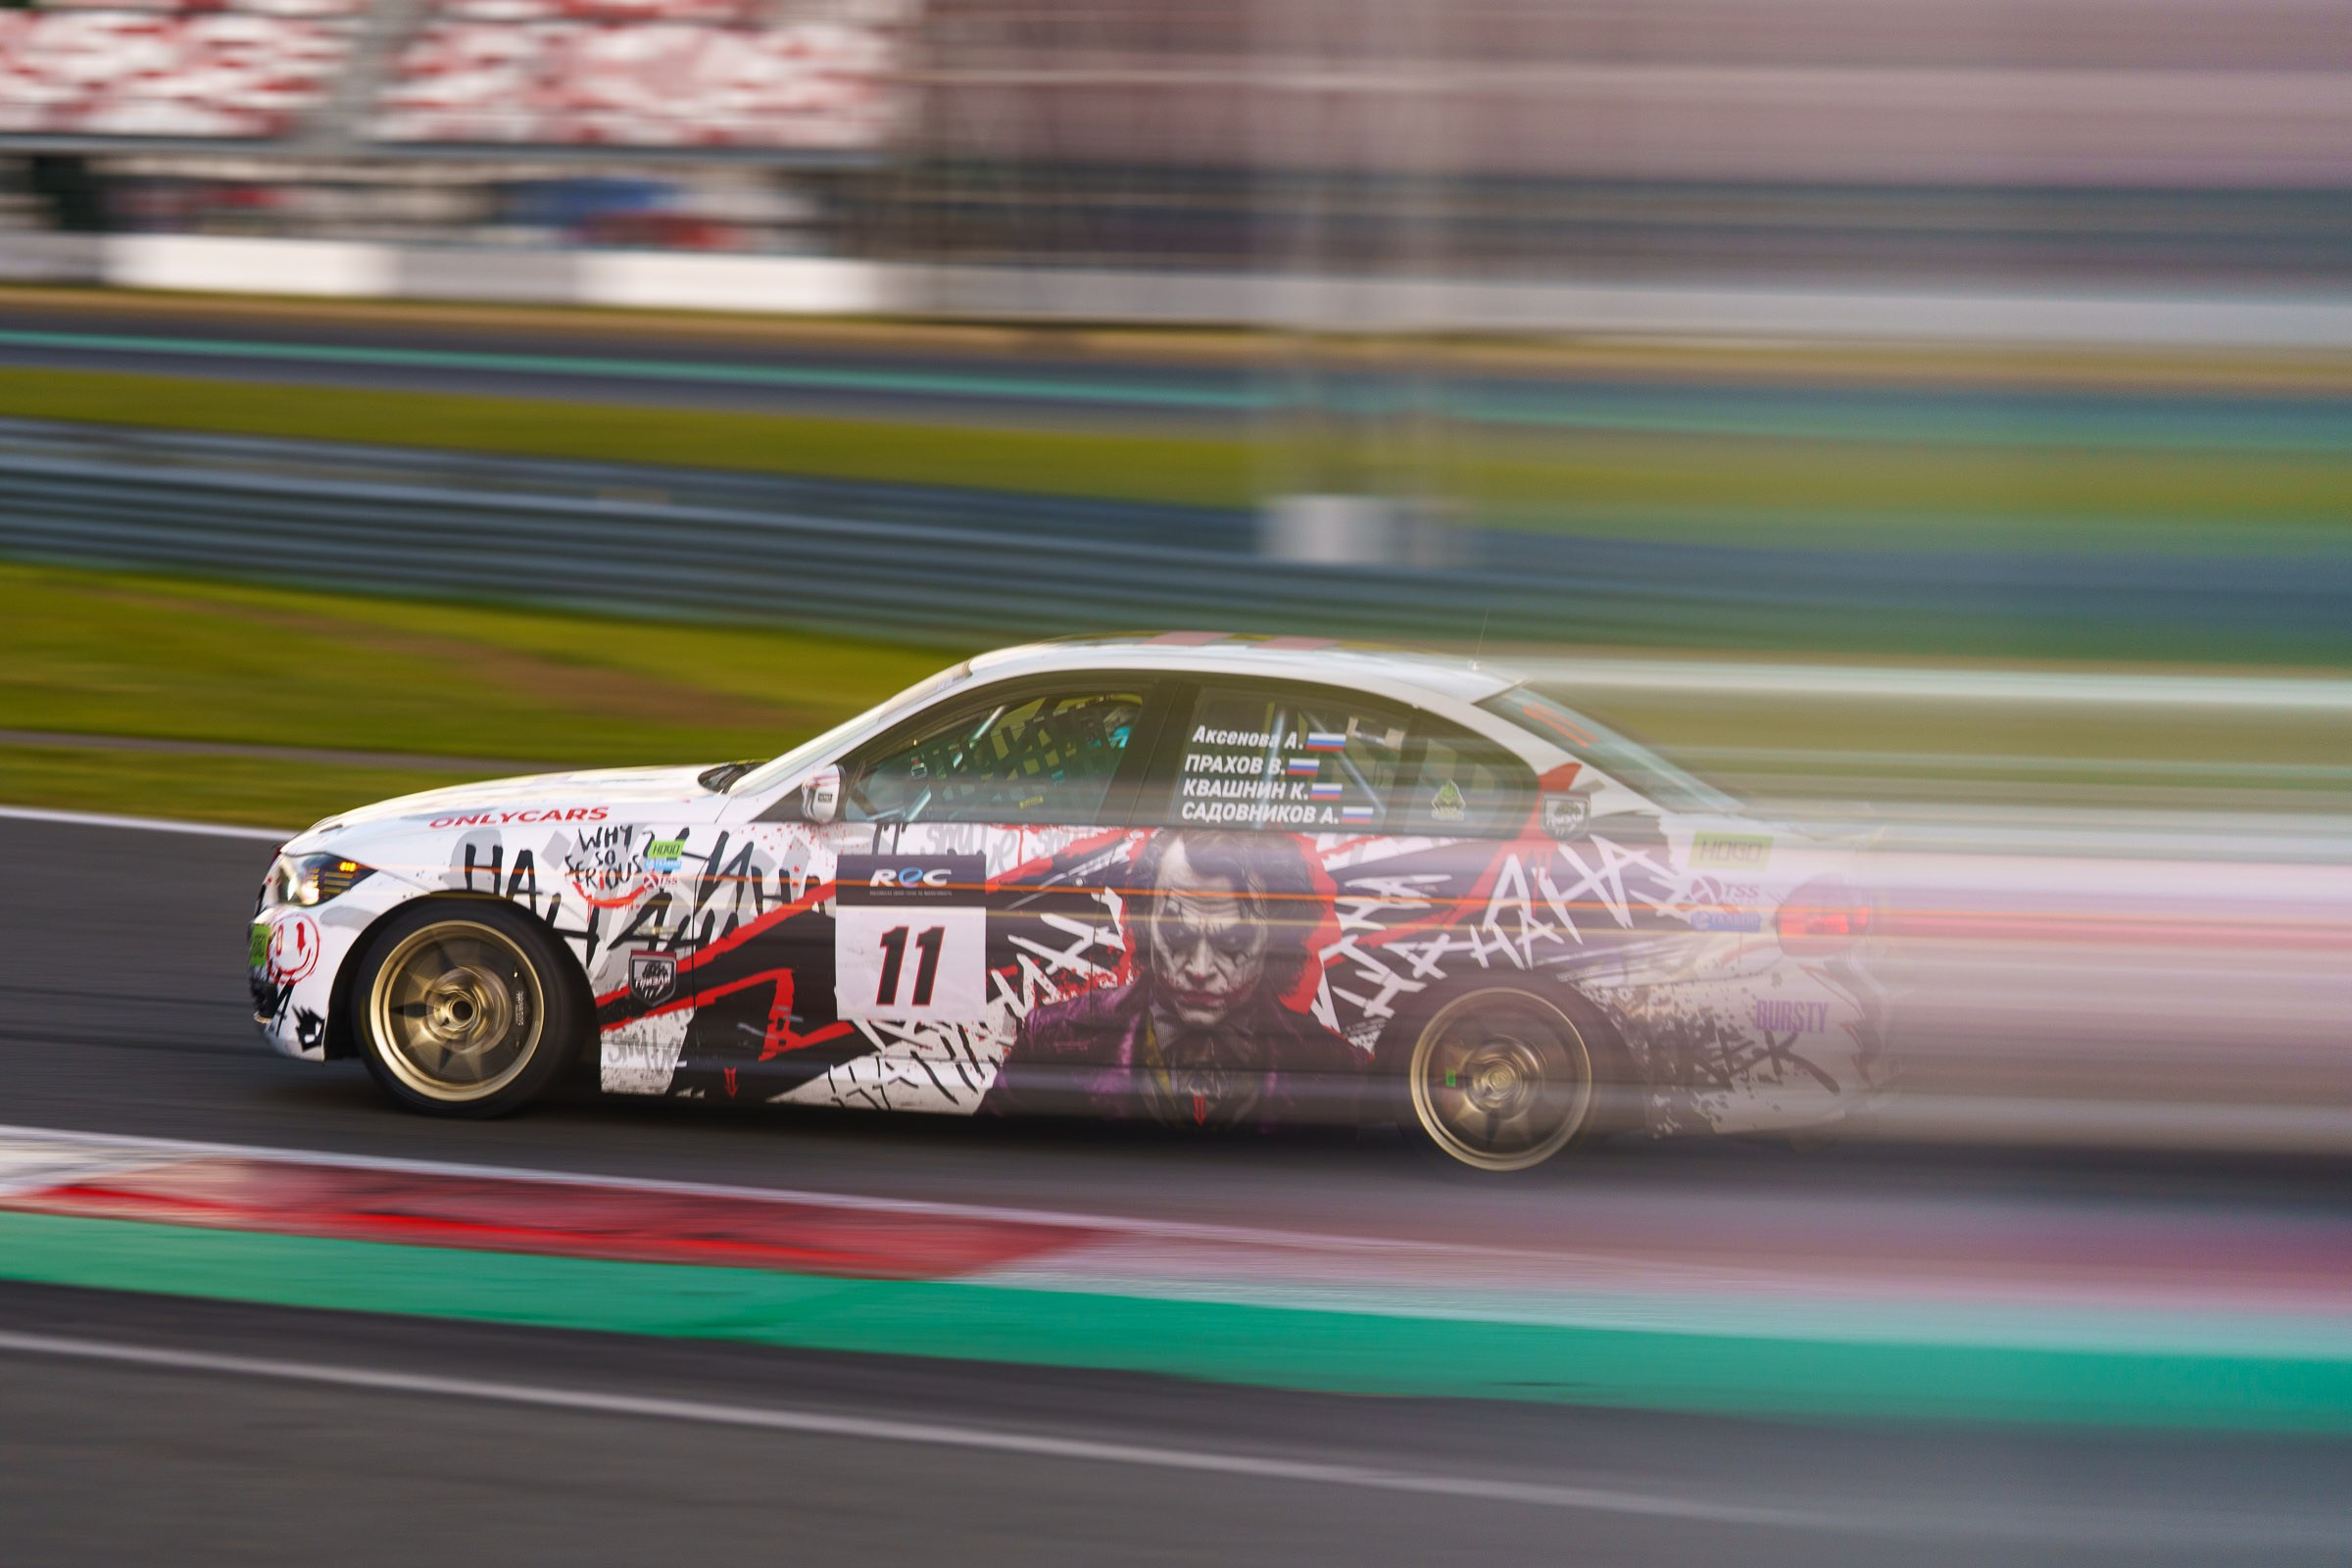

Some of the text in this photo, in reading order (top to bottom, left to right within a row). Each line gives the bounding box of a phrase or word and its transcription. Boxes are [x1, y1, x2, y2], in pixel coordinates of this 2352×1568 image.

[1285, 732, 1303, 751] А.
[1184, 755, 1286, 776] ПРАХОВ В.
[1183, 778, 1308, 801] КВАШНИН К.
[429, 807, 610, 829] ONLYCARS
[1181, 802, 1340, 824] САДОВНИКОВ А.
[578, 824, 633, 854] WHY
[596, 850, 616, 865] SO
[1724, 882, 1760, 899] TSS
[875, 925, 947, 1006] 11
[1755, 1000, 1830, 1034] BURSTY
